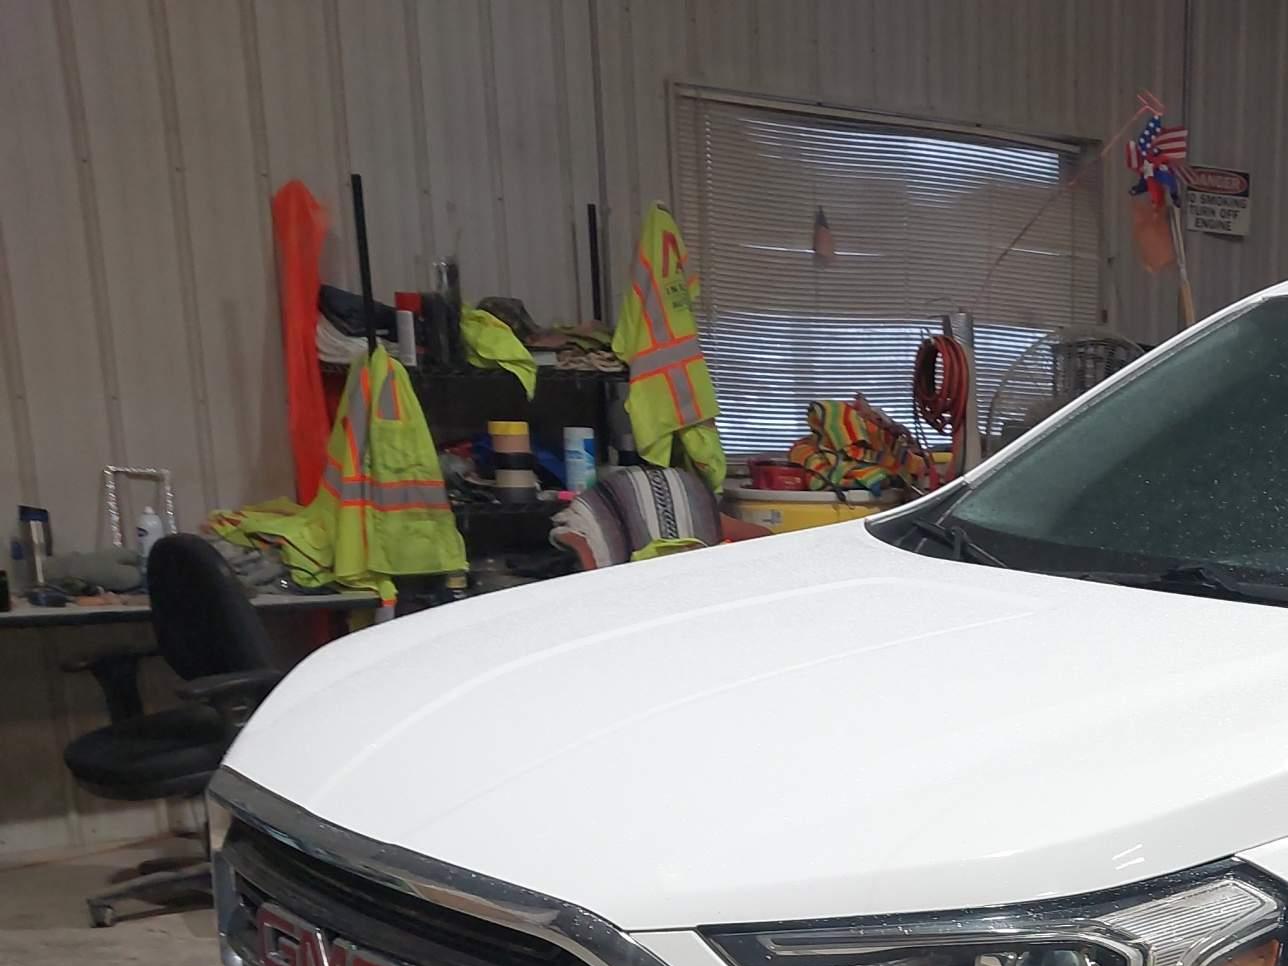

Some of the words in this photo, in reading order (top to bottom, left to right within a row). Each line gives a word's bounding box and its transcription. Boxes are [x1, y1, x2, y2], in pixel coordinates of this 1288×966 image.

[1200, 194, 1247, 209] SMOKING
[1189, 204, 1216, 217] TURN
[1219, 208, 1240, 219] OFF
[1195, 217, 1232, 232] ENGINE
